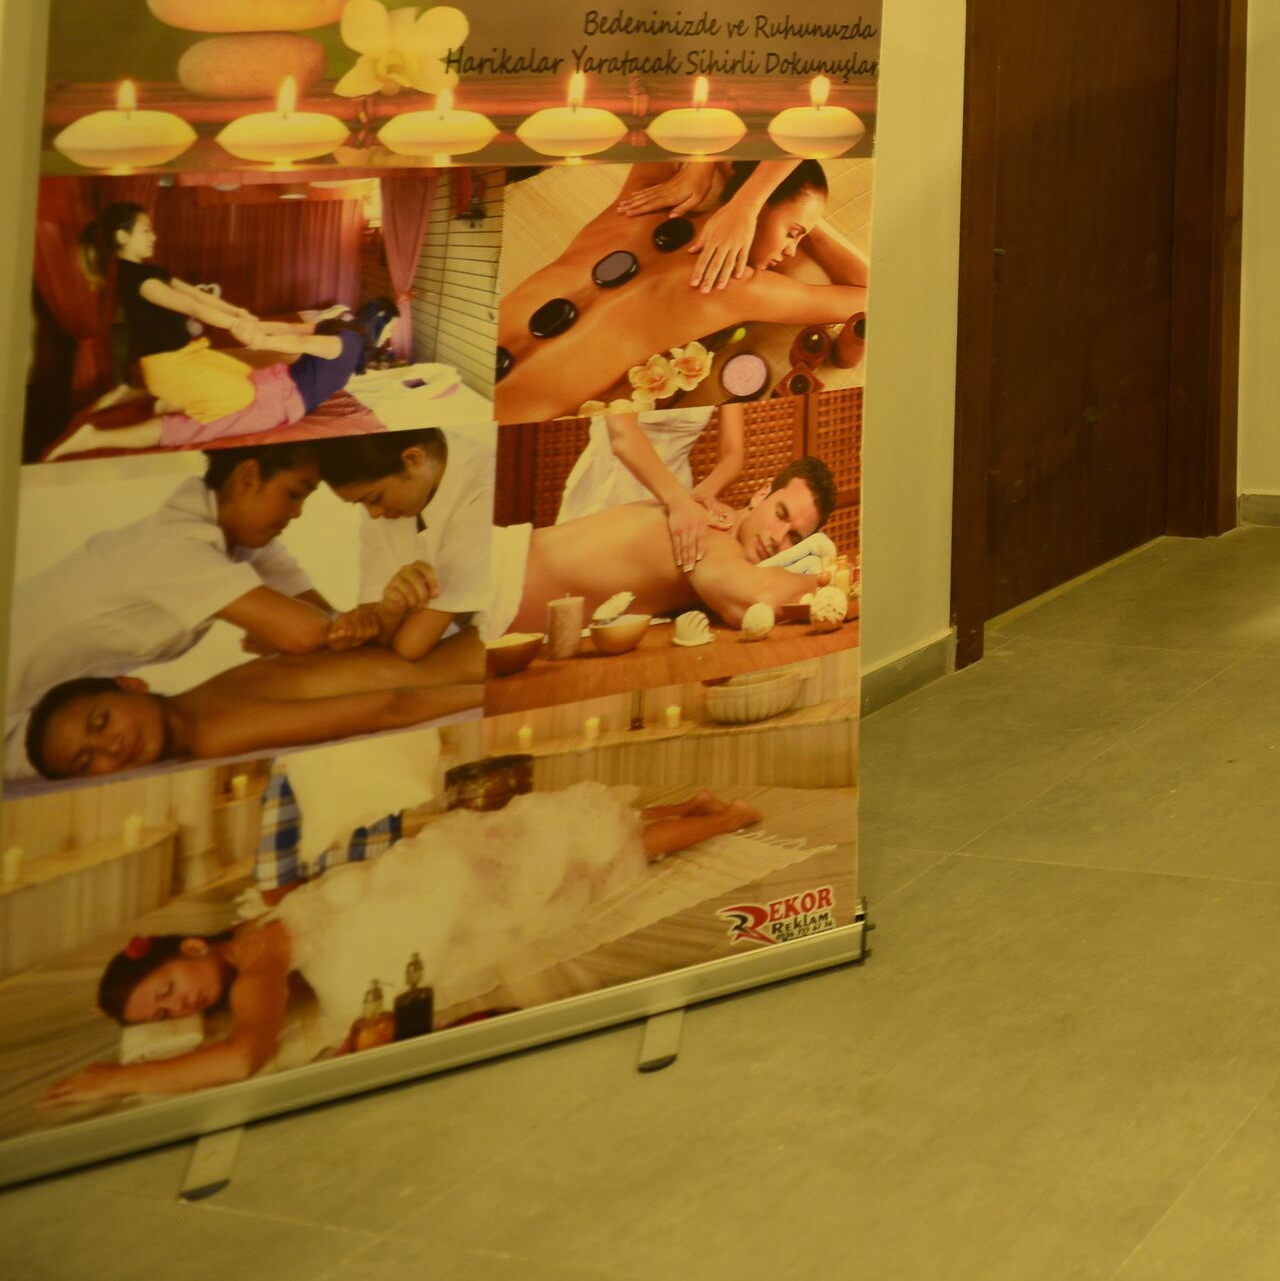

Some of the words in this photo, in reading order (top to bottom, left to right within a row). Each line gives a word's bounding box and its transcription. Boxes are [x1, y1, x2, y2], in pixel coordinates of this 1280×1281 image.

[583, 9, 722, 37] Bedeninizde
[727, 17, 749, 39] ve
[754, 14, 879, 41] Ruhunuzda
[444, 44, 565, 75] Harikalar
[571, 44, 683, 76] Yaratacak
[685, 49, 761, 76] Sihirli
[764, 51, 880, 84] Dokunuşlar
